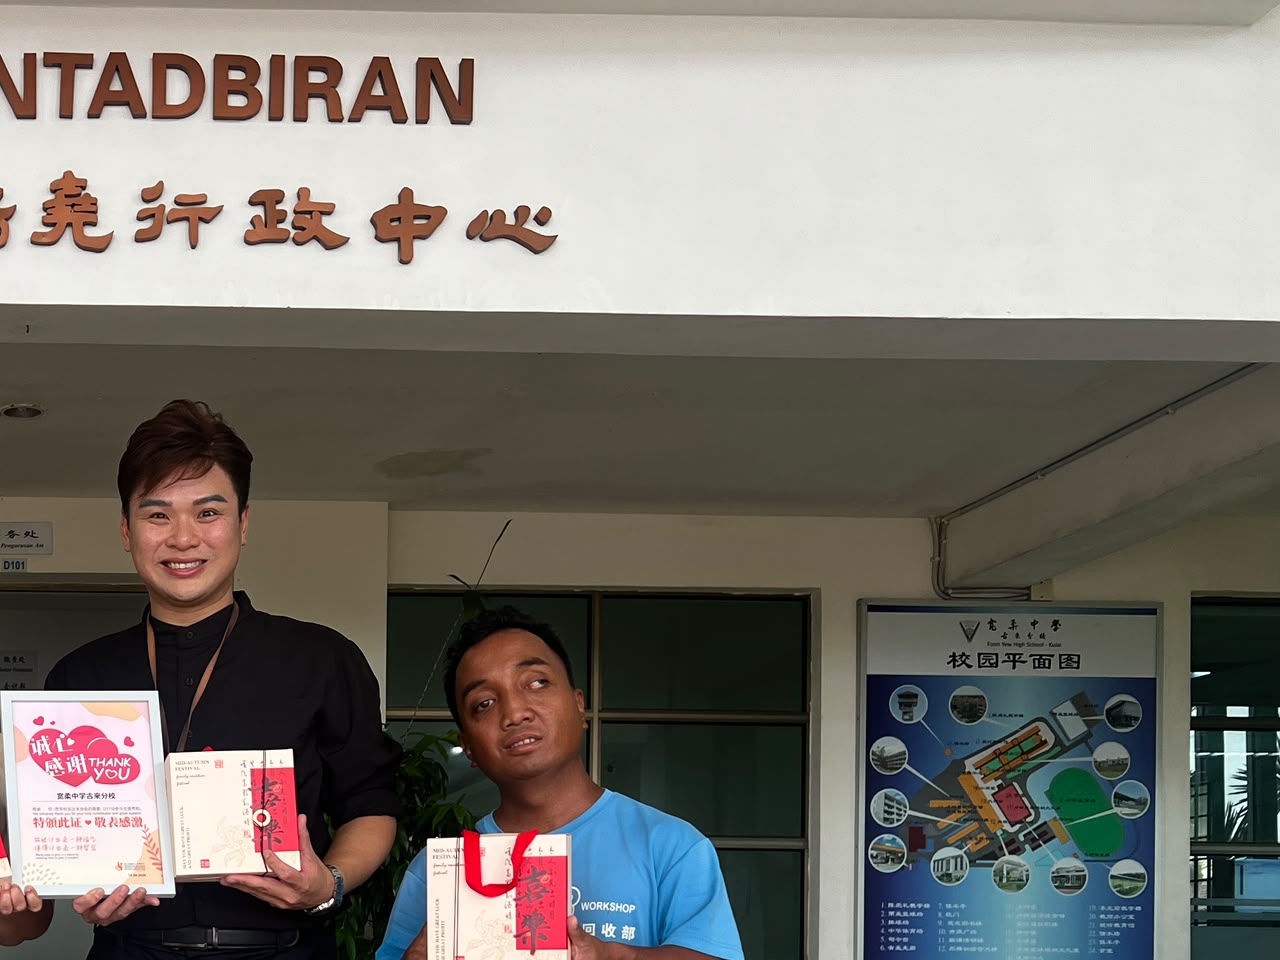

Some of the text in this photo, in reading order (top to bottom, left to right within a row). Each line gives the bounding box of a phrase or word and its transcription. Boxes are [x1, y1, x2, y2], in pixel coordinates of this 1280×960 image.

[3, 560, 25, 570] D101
[946, 651, 1081, 670] 校园平面图
[44, 753, 88, 777] 感谢
[88, 757, 132, 768] THANK
[94, 767, 131, 780] YOU
[581, 902, 636, 913] WORKSHOP
[582, 922, 636, 941] 回收部
